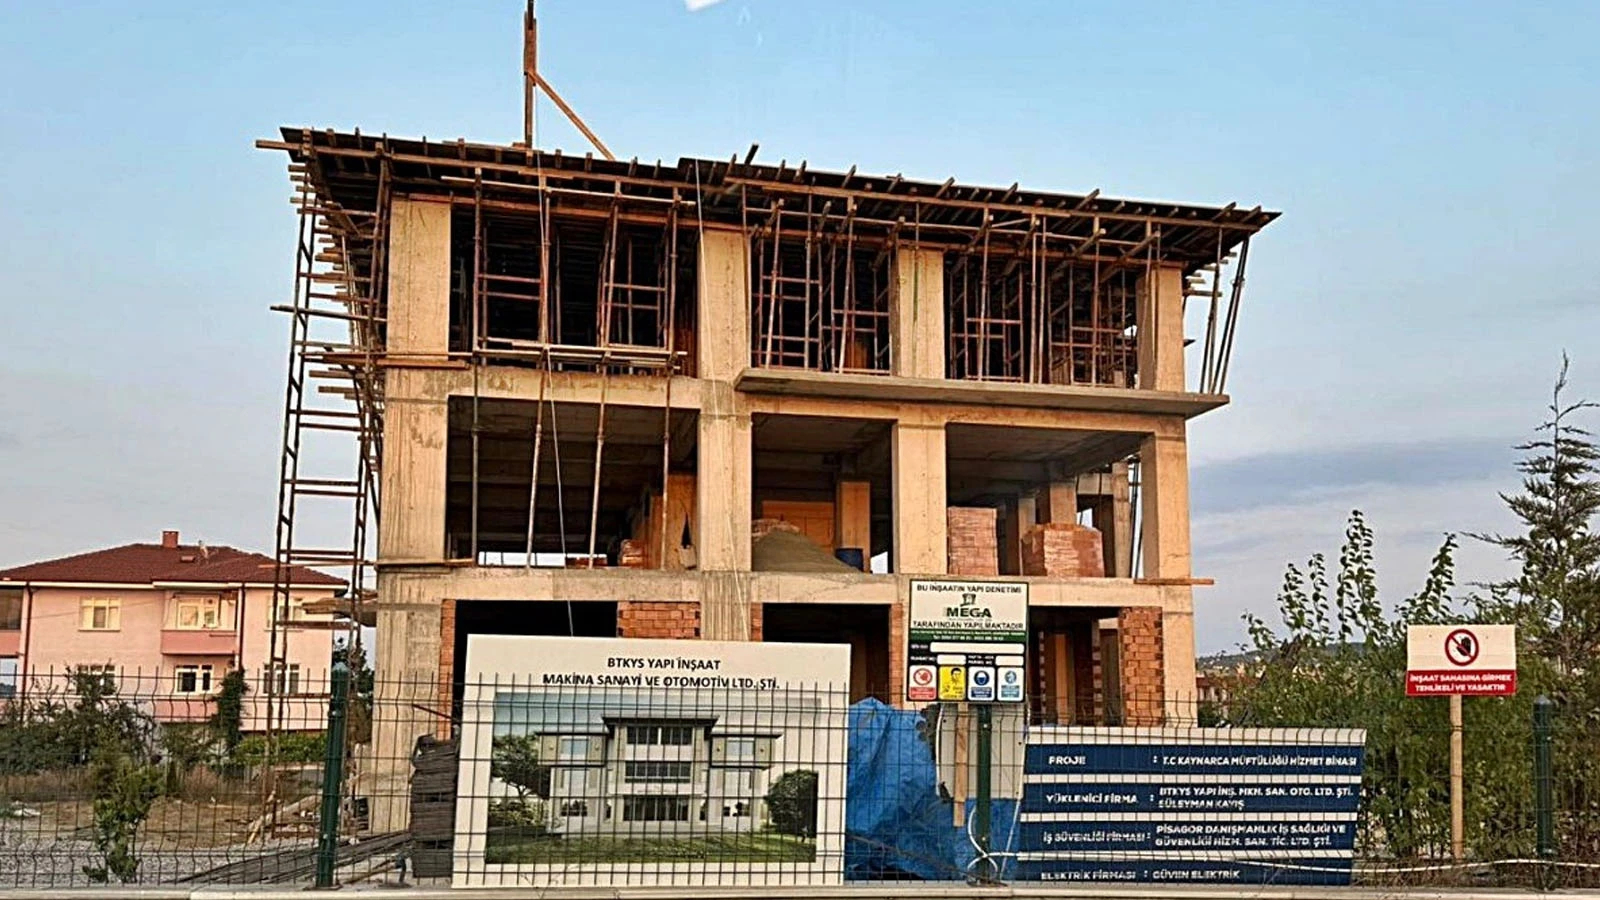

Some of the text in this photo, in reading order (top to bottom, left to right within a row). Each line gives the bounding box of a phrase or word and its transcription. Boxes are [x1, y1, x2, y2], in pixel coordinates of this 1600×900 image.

[930, 584, 965, 593] İNŞAATIN
[967, 585, 984, 593] YAPI
[985, 586, 1022, 594] DENETİMİ
[946, 607, 992, 618] MEGA
[913, 620, 1023, 630] TARAFINDAN YAPILMAKTADIR
[607, 656, 721, 672] BTKYS YAPI İNŞAAT
[542, 672, 780, 691] MAKİNA SANAYİ VE OTOMOTİV LTD. ŞTİ.
[1409, 673, 1513, 683] İNŞAAT SAHASINA GİRMEK
[1415, 683, 1454, 692] TEHLİKELİ
[1048, 755, 1087, 765] PROJE
[1177, 756, 1230, 766] KAYNARCA
[1231, 754, 1289, 766] MÜFTÜLÜĞÜ
[1289, 754, 1324, 766] HİZMET
[1325, 754, 1357, 766] BİNASI
[1193, 787, 1217, 796] YAPI
[1314, 787, 1335, 796] LTD.
[1046, 792, 1103, 803] YÜKLENİCİ
[1104, 792, 1138, 803] FİRMA
[1214, 800, 1245, 811] KAYIŞ
[1156, 823, 1203, 834] PİSAGOR
[1204, 824, 1278, 836] DANIŞMANLIK
[1290, 822, 1331, 834] SAĞLIĞI
[1332, 825, 1346, 834] VE
[1043, 831, 1051, 844] İŞ
[1106, 831, 1145, 842] FİRMASI
[1155, 835, 1212, 846] GÜVENLİĞİ
[1213, 835, 1242, 846] HİZM.
[1245, 837, 1269, 846] SAN.
[1041, 869, 1091, 880] ELEKTRİK
[1092, 869, 1136, 880] FİRMASI
[1152, 868, 1189, 880] GÜVEN
[1191, 868, 1241, 880] ELEKTRİK
